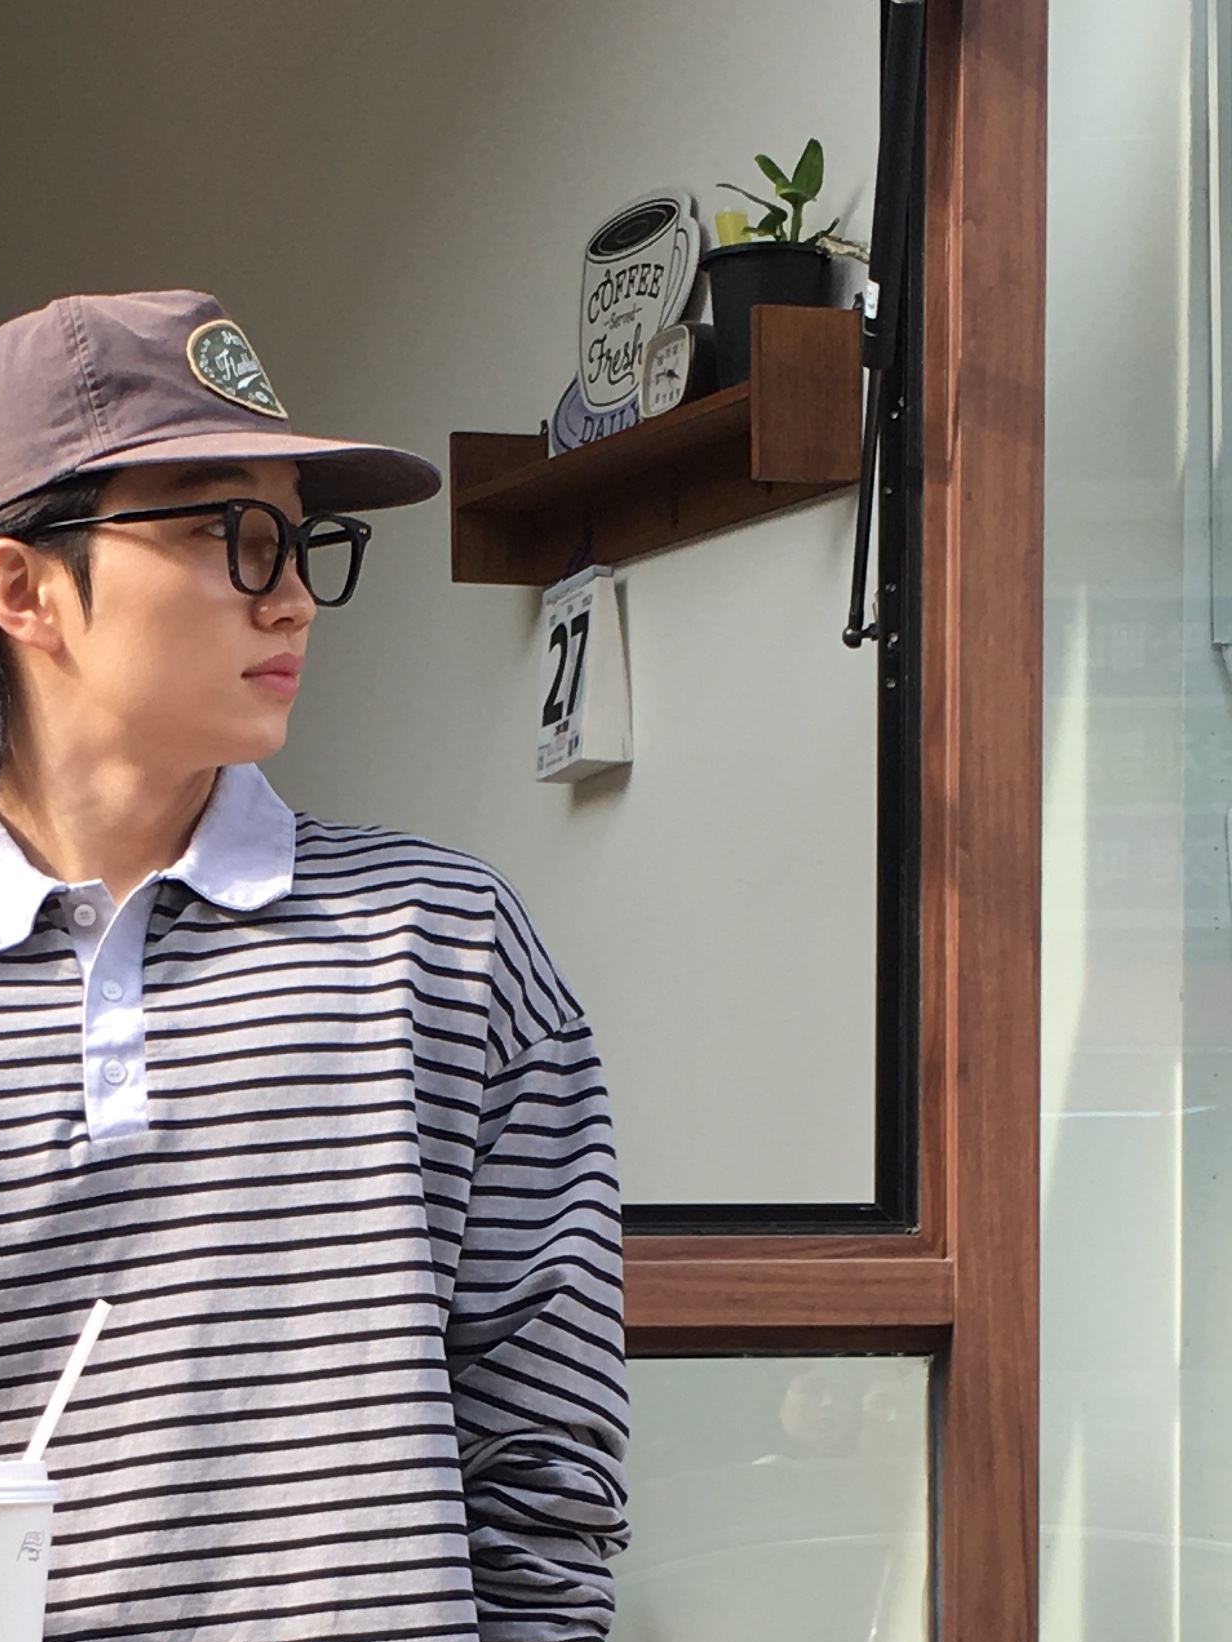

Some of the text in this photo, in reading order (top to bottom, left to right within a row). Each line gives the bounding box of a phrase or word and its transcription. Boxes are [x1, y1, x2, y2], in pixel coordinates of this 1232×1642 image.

[588, 263, 664, 324] COFFEE
[588, 322, 643, 385] Fresh
[541, 609, 590, 728] 27
